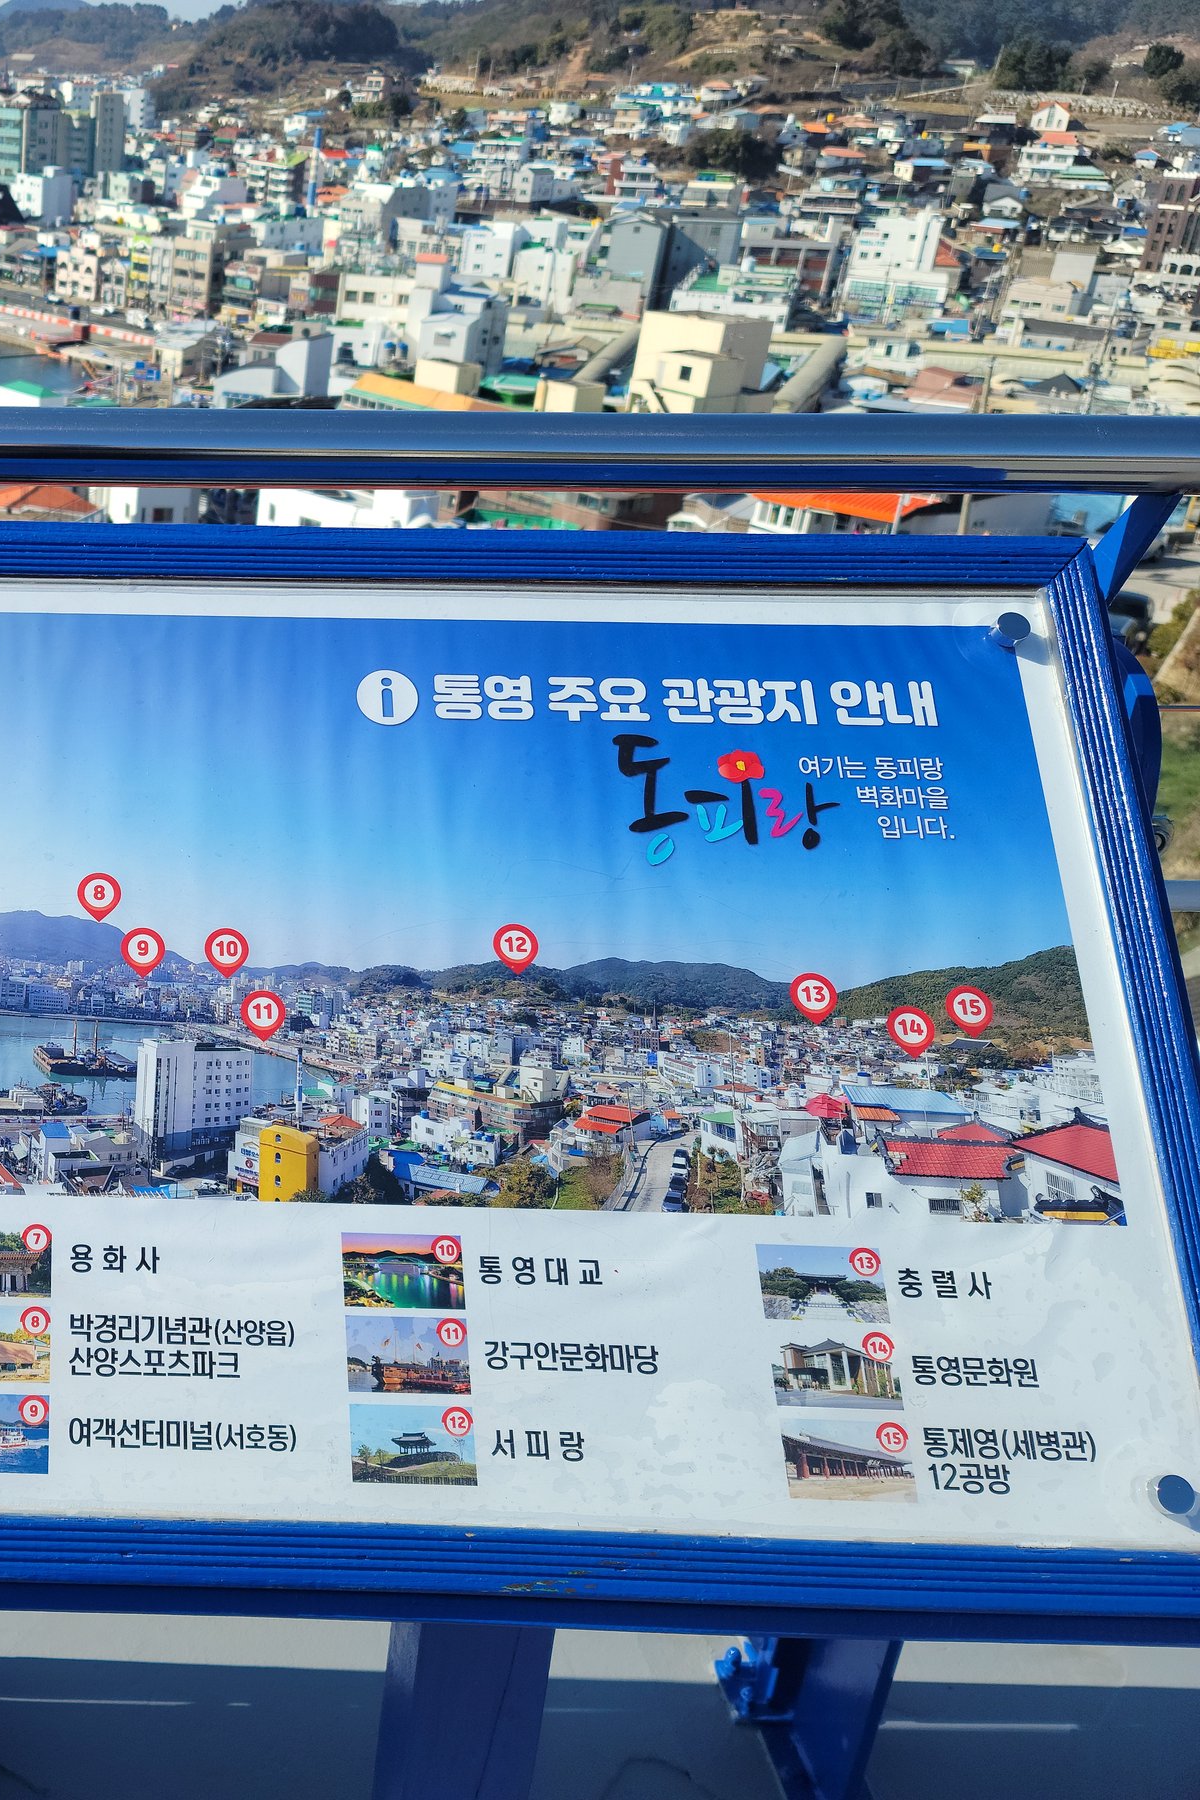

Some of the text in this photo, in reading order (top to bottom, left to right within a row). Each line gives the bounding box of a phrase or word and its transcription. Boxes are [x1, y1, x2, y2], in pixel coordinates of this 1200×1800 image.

[433, 673, 939, 727] 통영 주요 관광지 안내
[798, 754, 943, 782] 여기는 동피랑
[611, 733, 841, 867] 동피랑
[855, 785, 949, 811] 벽화마을
[876, 815, 955, 841] 입니다.
[93, 885, 106, 900] 8
[136, 940, 149, 956] 9
[216, 940, 238, 956] 10
[504, 936, 528, 952] 12
[801, 985, 826, 1002] 13
[253, 1003, 274, 1018] 11
[957, 998, 981, 1015] 15
[897, 1018, 924, 1035] 14
[32, 1232, 41, 1246] 7
[438, 1244, 455, 1257] 10
[856, 1256, 874, 1269] 13
[30, 1315, 40, 1329] 8
[444, 1327, 460, 1340] 11
[869, 1341, 888, 1354] 14
[68, 1347, 240, 1378] 산양스포츠파크
[484, 1341, 659, 1373] 강구안문화마당
[912, 1355, 1039, 1387] 통영문화원
[29, 1404, 39, 1418] 9
[449, 1416, 467, 1429] 12
[884, 1431, 902, 1446] 15
[928, 1463, 1010, 1493] 12공방
